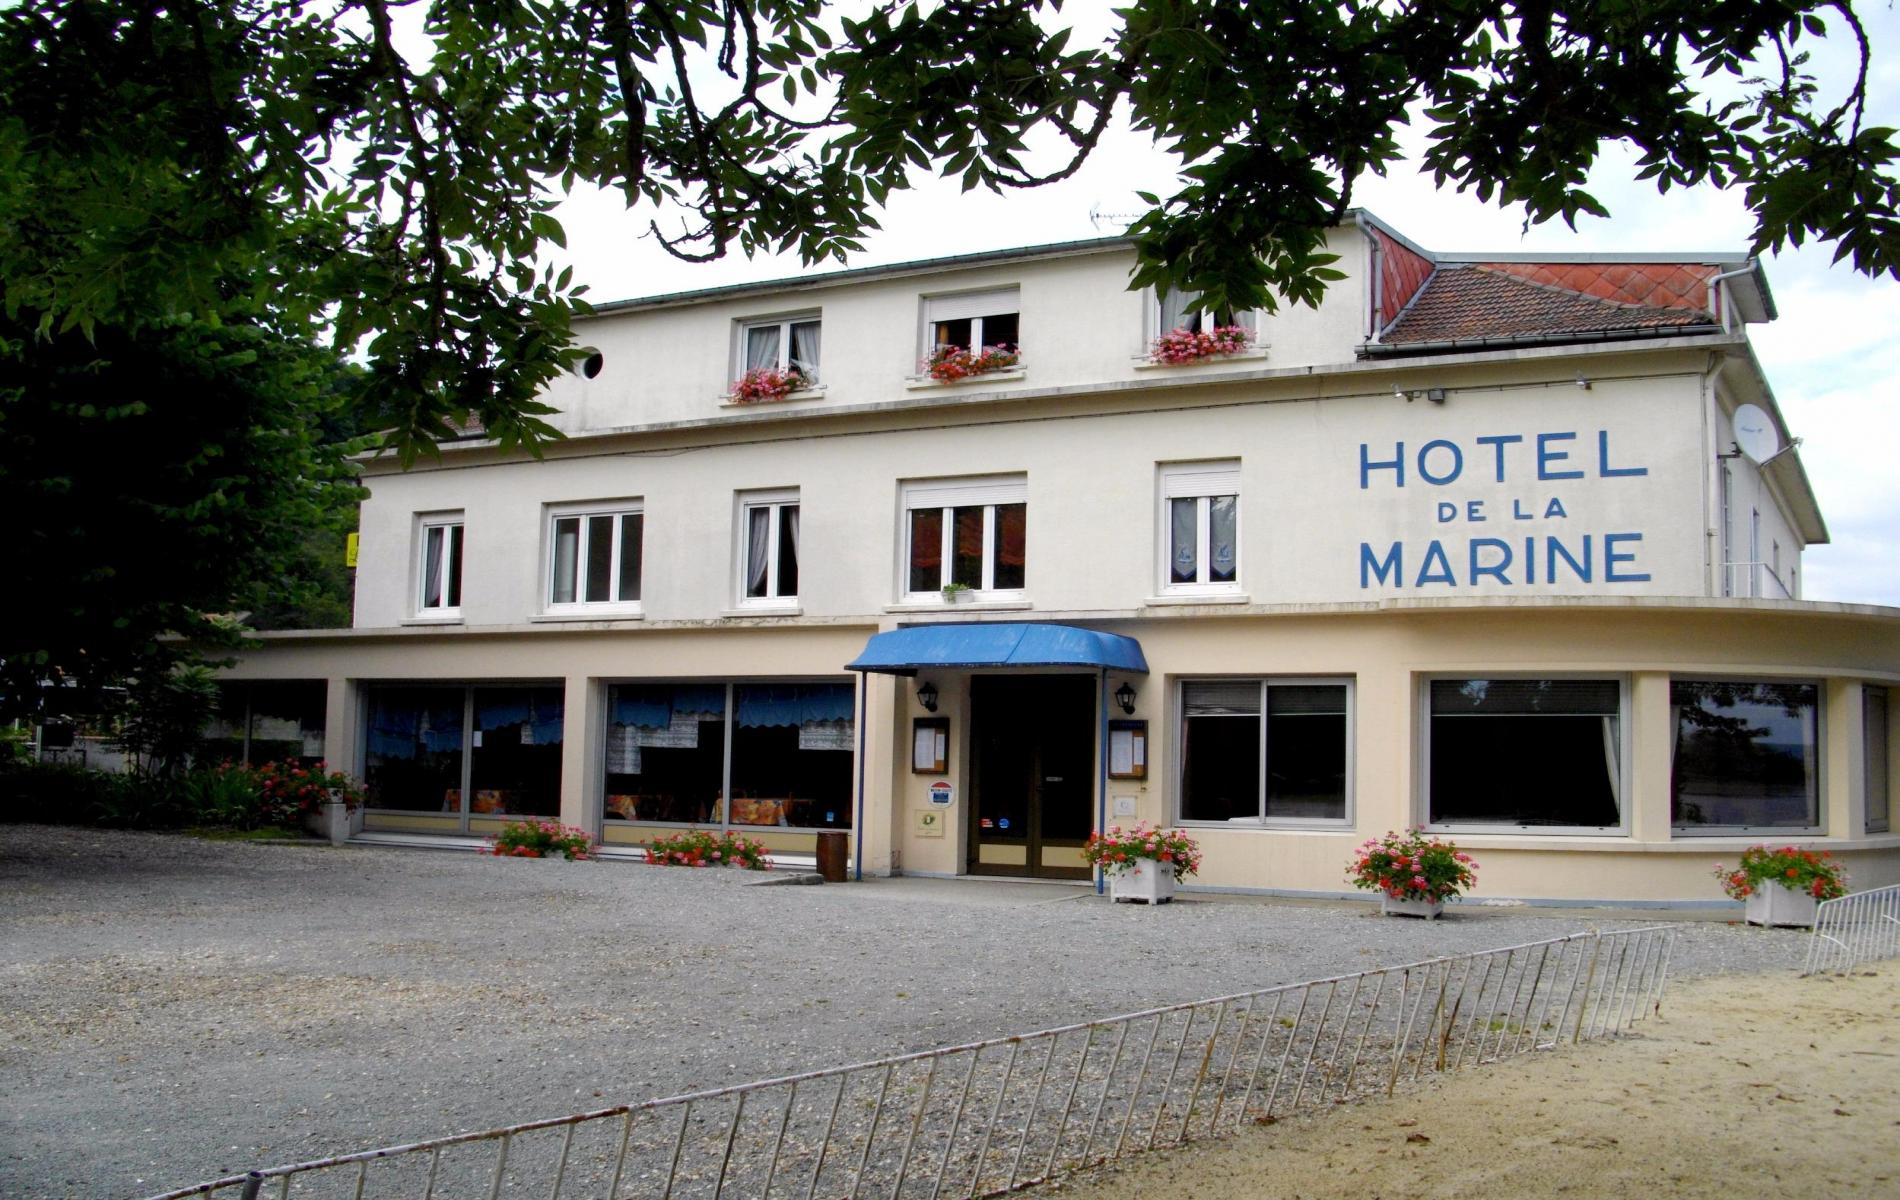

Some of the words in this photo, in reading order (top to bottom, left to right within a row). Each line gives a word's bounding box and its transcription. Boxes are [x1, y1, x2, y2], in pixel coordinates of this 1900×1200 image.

[1360, 430, 1648, 489] HOTEL
[1438, 500, 1487, 523] DE
[1513, 497, 1567, 520] LA
[1360, 532, 1652, 589] MARINE
